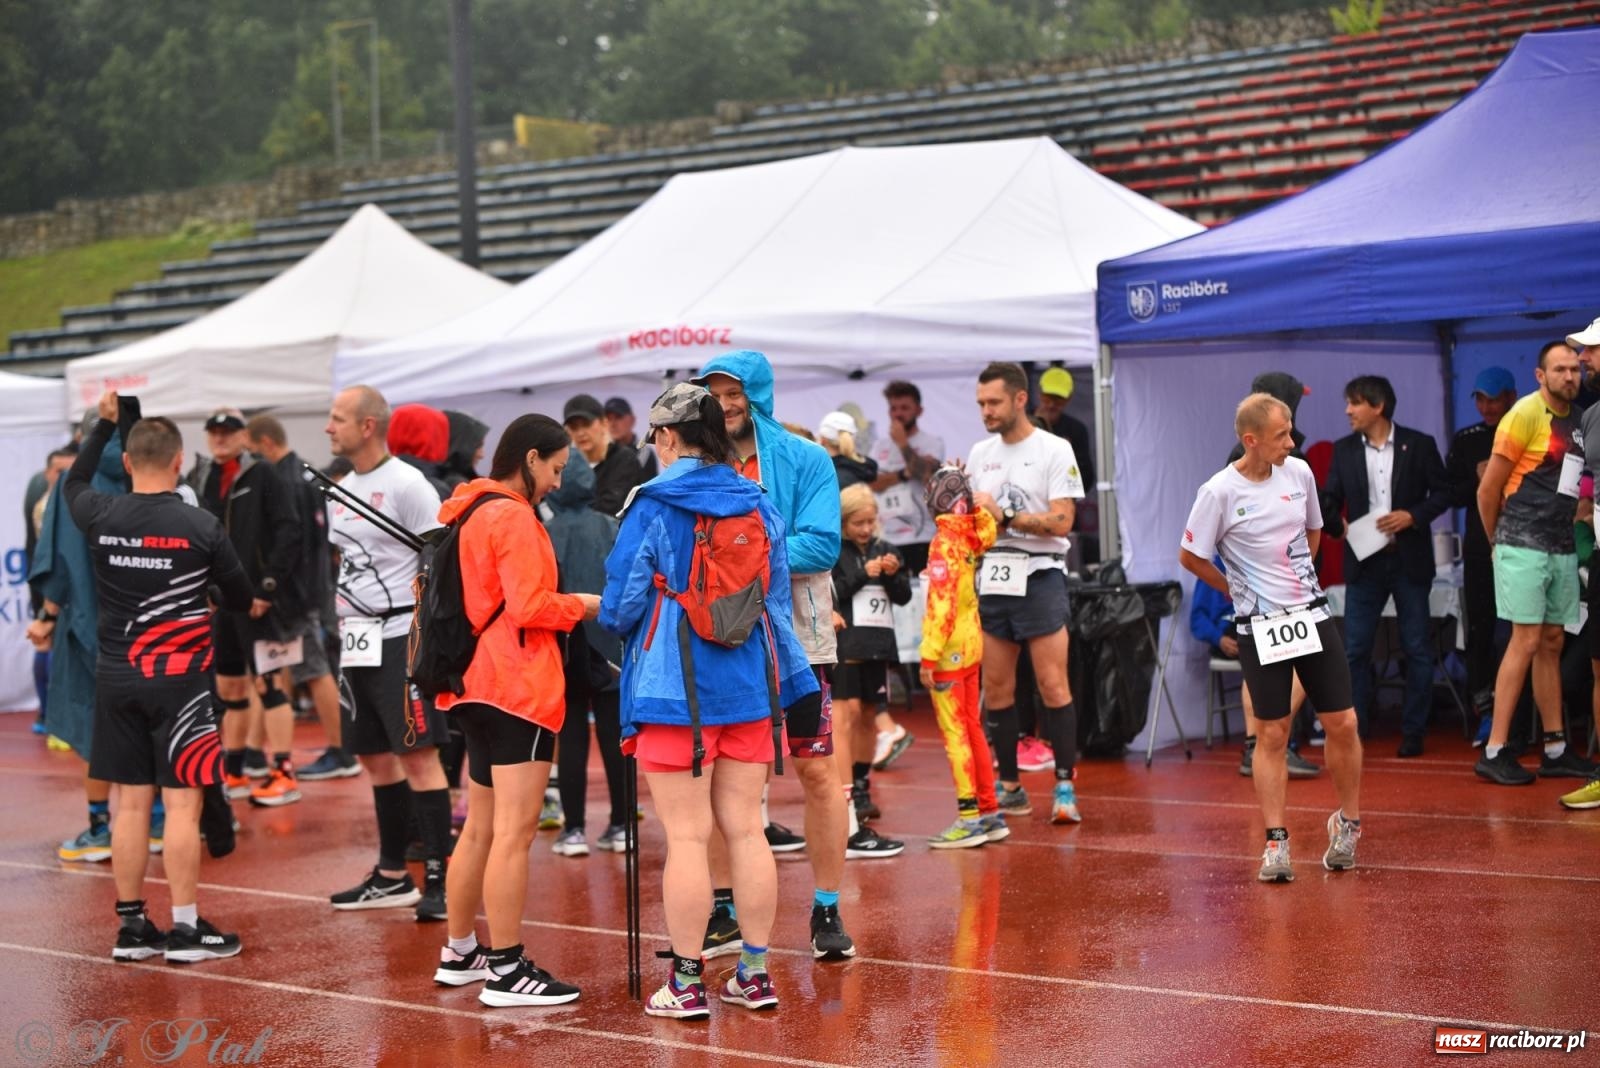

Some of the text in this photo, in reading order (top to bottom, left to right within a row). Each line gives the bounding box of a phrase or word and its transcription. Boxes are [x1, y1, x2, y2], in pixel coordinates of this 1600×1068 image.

[1161, 280, 1230, 299] Racibórz
[108, 554, 173, 570] MARIUSZ
[990, 564, 1011, 582] 23
[869, 597, 888, 615] 97
[1266, 620, 1309, 647] 100
